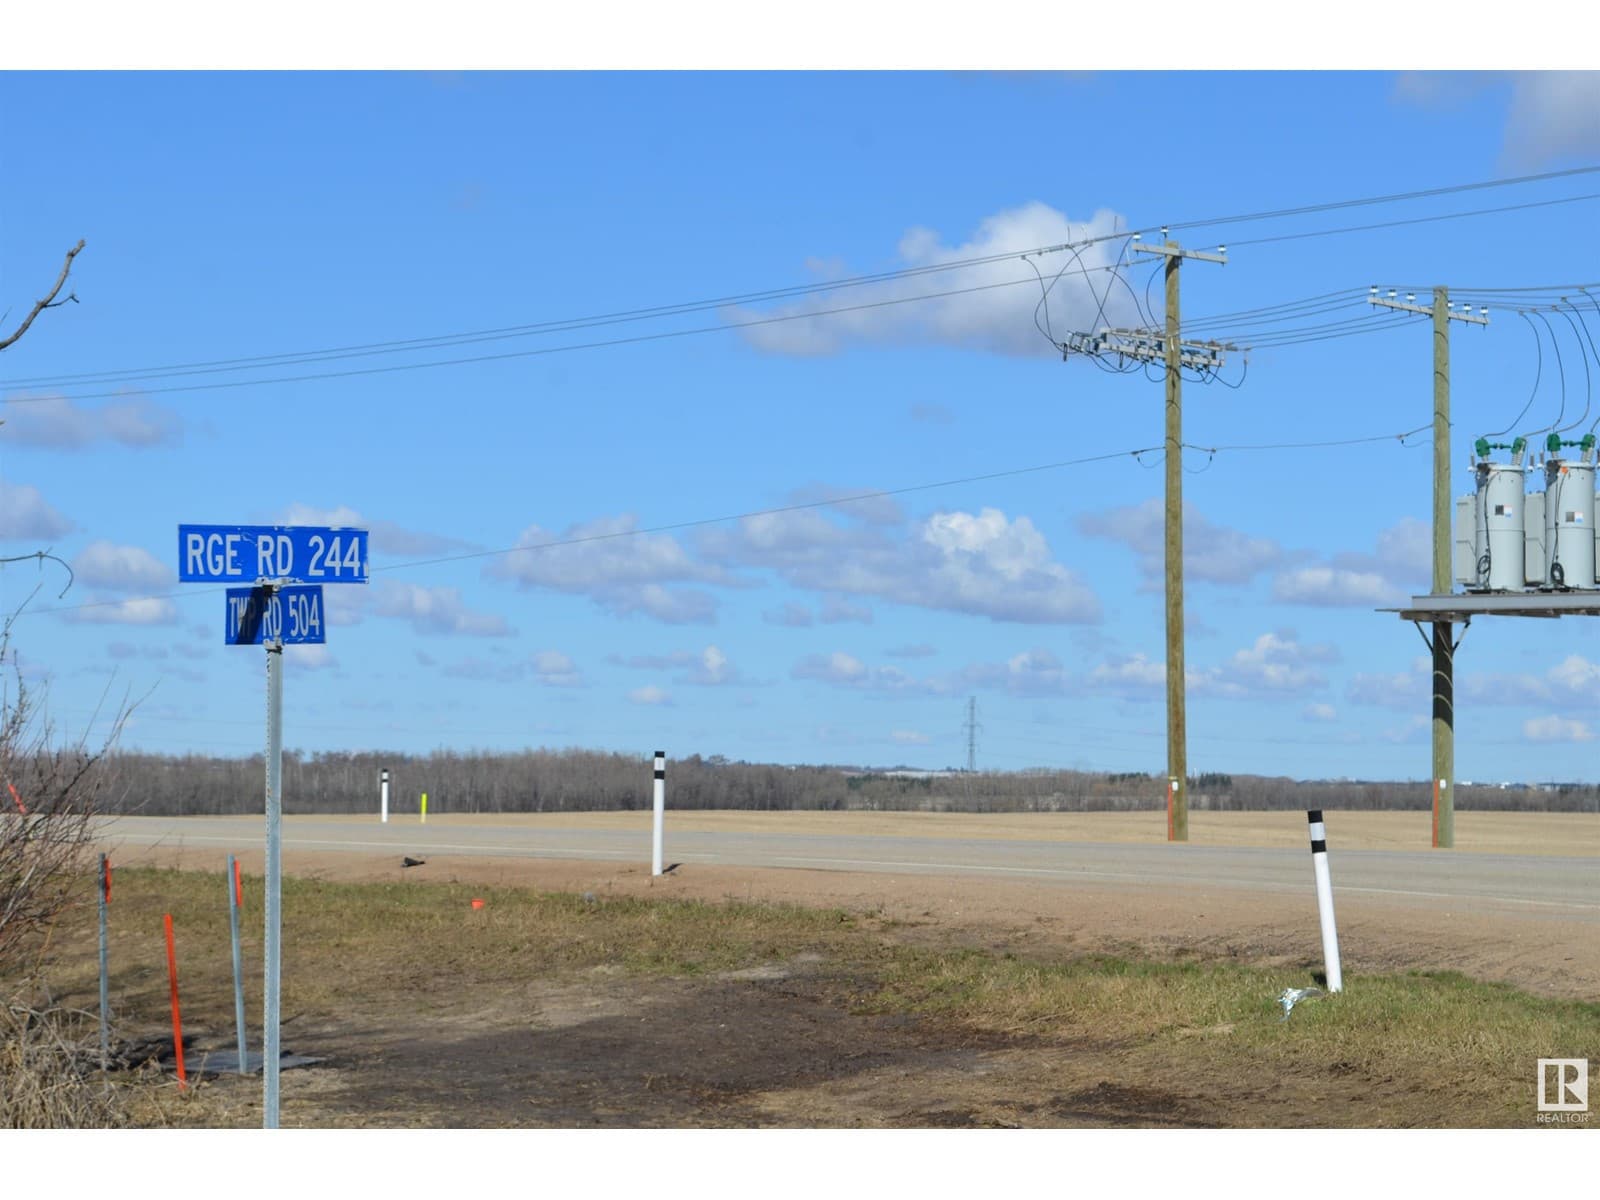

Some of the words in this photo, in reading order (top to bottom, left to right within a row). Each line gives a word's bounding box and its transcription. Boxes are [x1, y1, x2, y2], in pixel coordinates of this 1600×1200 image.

[186, 533, 243, 576] RGE
[257, 534, 294, 576] RD
[308, 535, 361, 577] 244
[263, 595, 283, 637] RD
[288, 594, 320, 638] 504
